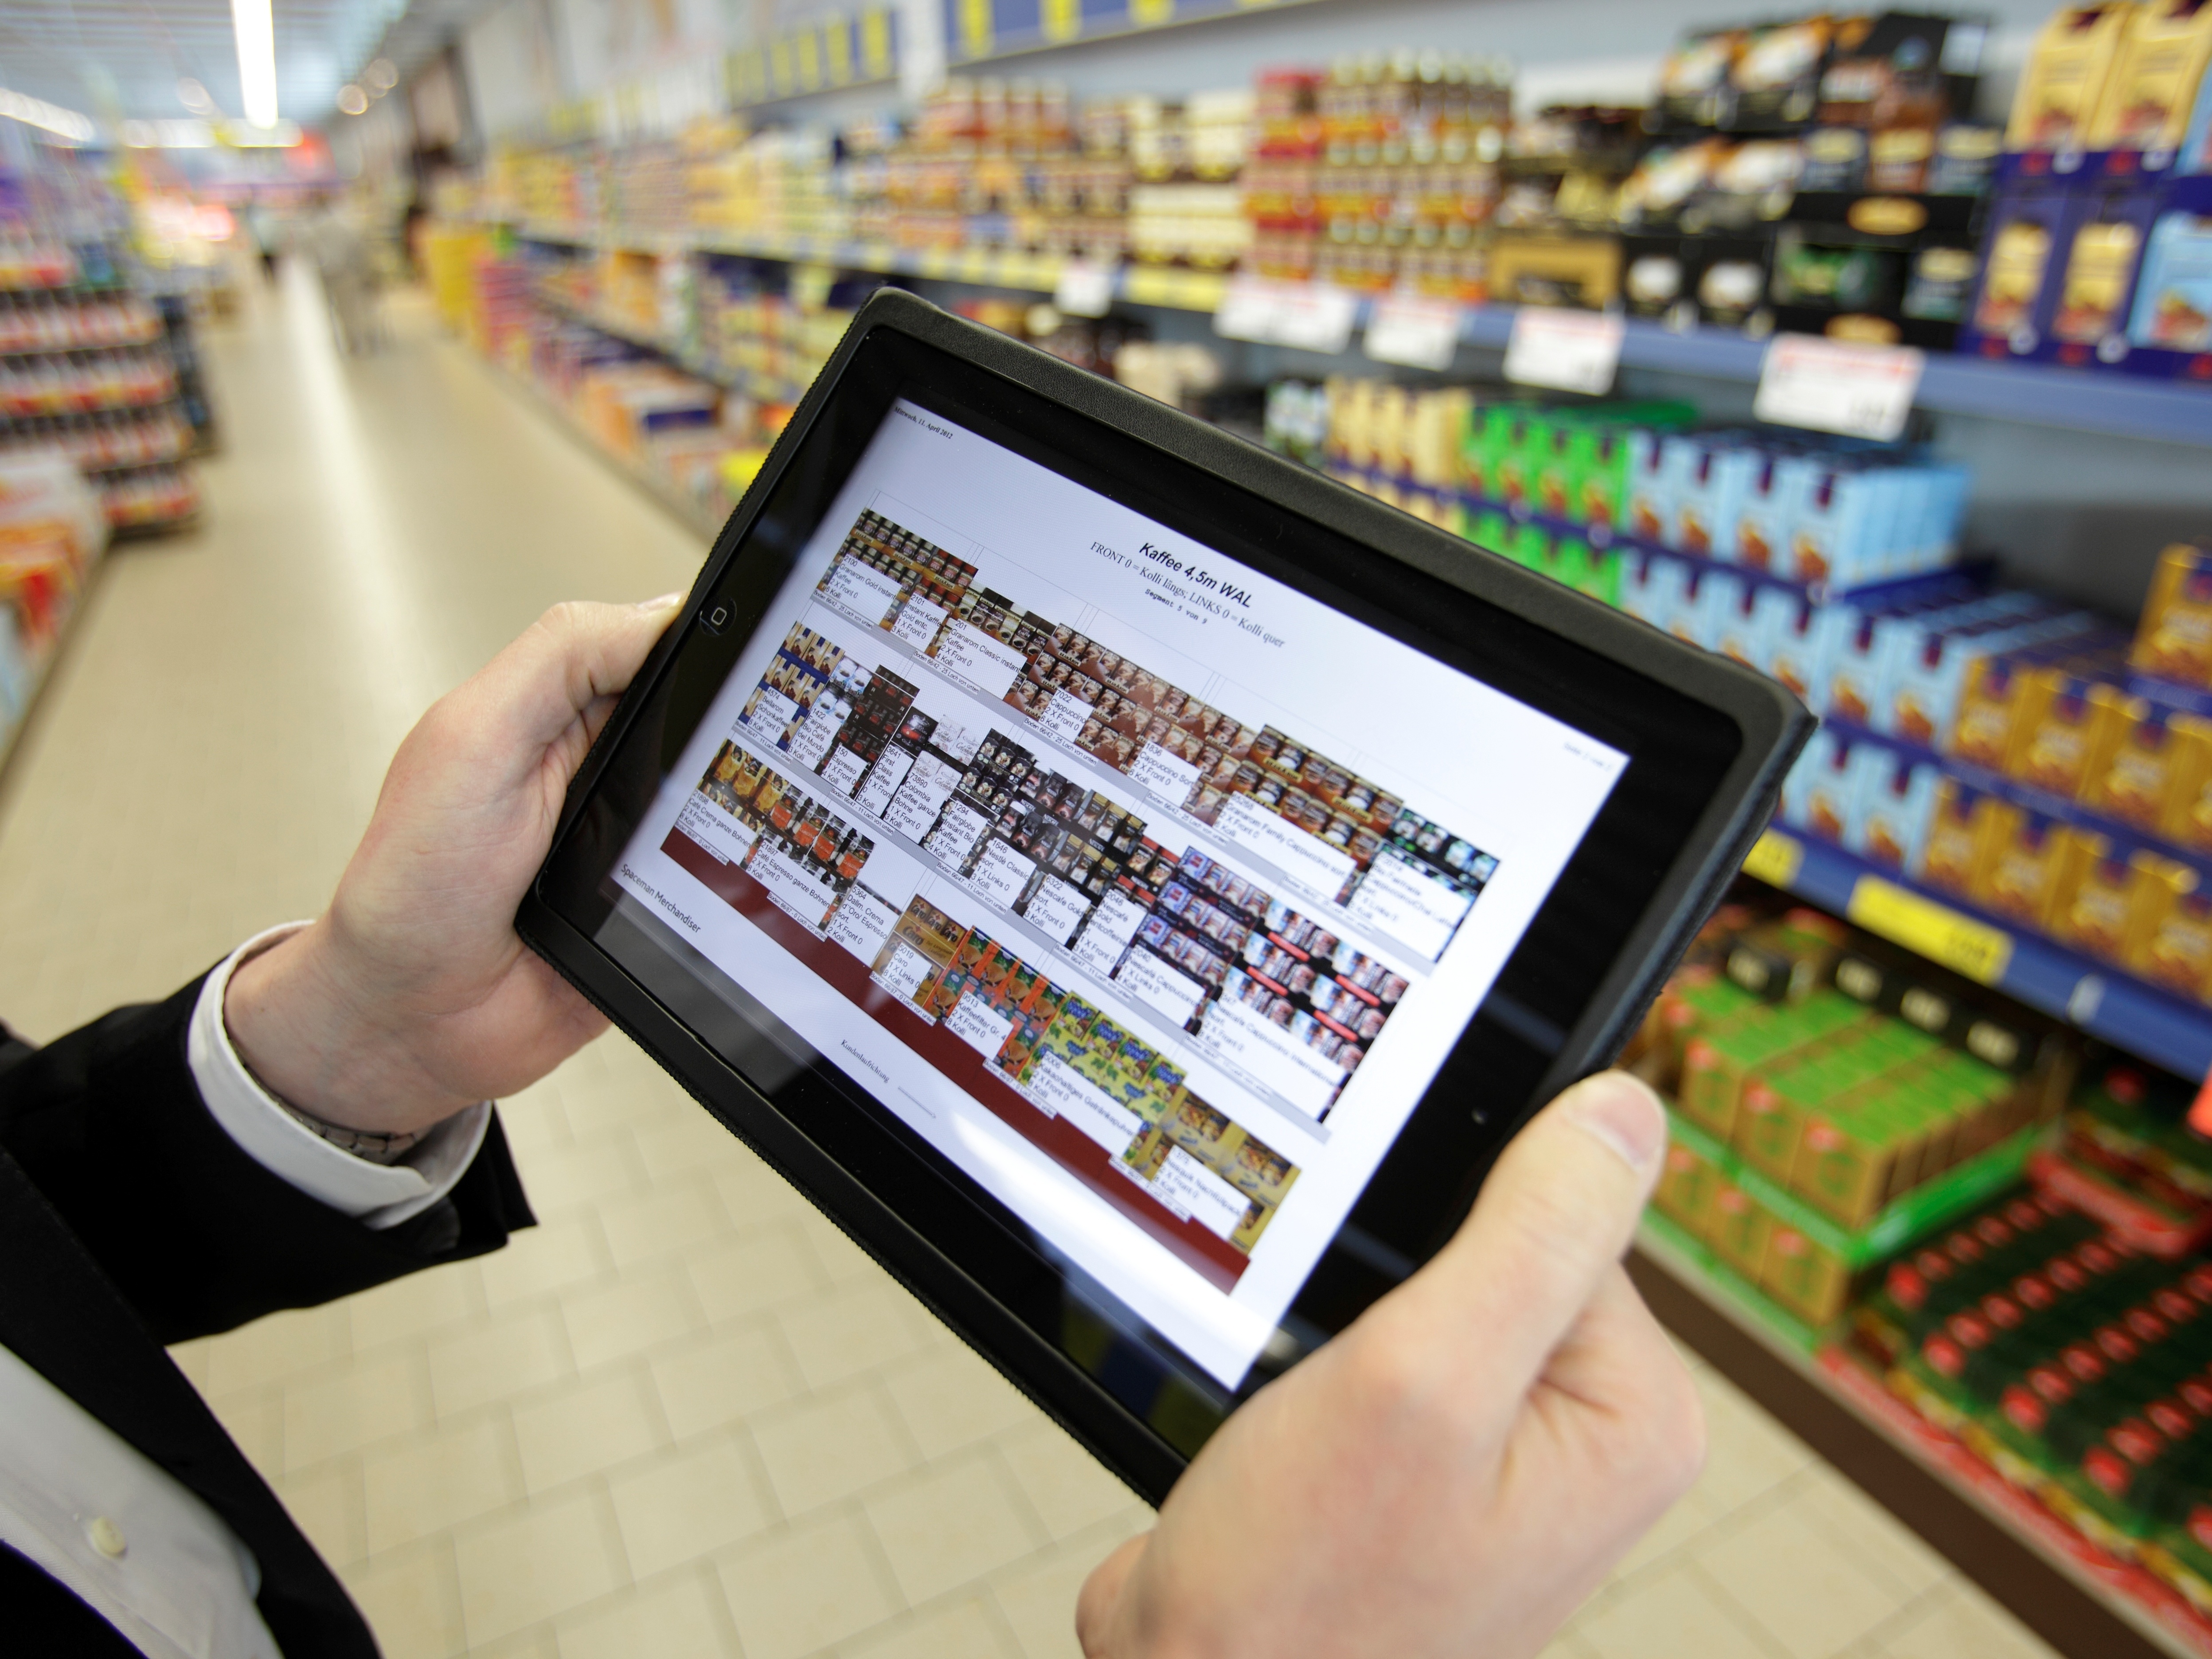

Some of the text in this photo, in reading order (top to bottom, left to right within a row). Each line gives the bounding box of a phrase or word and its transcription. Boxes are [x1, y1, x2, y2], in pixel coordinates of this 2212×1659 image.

[926, 422, 941, 434] April
[939, 429, 953, 439] 2012
[844, 555, 858, 567] 2100
[834, 571, 852, 585] Kaffee
[839, 563, 896, 600] Granarom Gold instant
[1138, 541, 1255, 608] Kaffee 4,5m WAL
[910, 594, 925, 606] 2101
[1090, 540, 1126, 564] FRONT
[1124, 558, 1133, 568] 0
[1140, 566, 1163, 584] Kolli
[1161, 578, 1190, 600] längs;
[1189, 591, 1223, 615] LINKS
[1221, 608, 1231, 619] 0
[1238, 617, 1263, 636] Kolli
[1262, 632, 1286, 650] quer
[906, 602, 925, 617] Instant
[1144, 588, 1177, 609] Segment
[1184, 610, 1200, 621] von
[900, 610, 915, 622] Gold
[955, 620, 967, 630] 201
[945, 636, 965, 651] Kaffee
[950, 628, 1021, 673] Granarom Classic instant
[940, 655, 954, 667] Kolli
[950, 650, 967, 664] Front
[766, 688, 780, 700] 4574
[1055, 689, 1072, 703] 7022
[762, 696, 785, 714] Bellarom
[1049, 698, 1087, 725] Cappuccino
[757, 703, 789, 728] Schonkaffee
[812, 708, 826, 720] 1422
[802, 723, 825, 742] Bio Café
[806, 715, 832, 736] Fairglobe
[797, 731, 825, 752] del Mundo
[837, 746, 848, 757] 150
[886, 745, 901, 759] 3641
[1145, 742, 1163, 757] 1836
[831, 754, 858, 776] Espresso
[881, 753, 895, 766] First
[1138, 751, 1179, 780] Cappuccino
[876, 762, 894, 776] Class
[872, 770, 891, 786] Kaffee
[909, 772, 928, 788] 73890
[693, 790, 709, 805] 21898
[904, 780, 932, 802] Colombia
[862, 797, 875, 810] Kolli
[894, 797, 914, 814] Bohne
[899, 788, 936, 818] Kaffee ganze
[954, 802, 969, 815] 1294
[688, 798, 752, 848] Café Crema ganze Bohnen
[889, 816, 903, 829] Kolli
[900, 812, 916, 826] Front
[947, 810, 977, 833] Fairglobe
[938, 826, 959, 844] Kaffee
[943, 818, 975, 843] Instant Bio
[761, 841, 778, 857] 21897
[933, 847, 947, 860] Kolli
[992, 839, 1008, 853] 1646
[1006, 861, 1030, 880] Classic
[756, 849, 831, 908] Café Espresso ganze Bohnen
[976, 876, 991, 890] Kolli
[987, 872, 1004, 887] Links
[1045, 875, 1063, 890] 6322
[619, 863, 702, 934] Spaceman Merchandiser
[852, 885, 867, 900] 5364
[837, 910, 851, 923] sort.
[847, 894, 885, 925] Dallm. Crema
[1067, 902, 1084, 916] Gold
[1094, 908, 1113, 923] Gold
[842, 926, 858, 941] Front
[860, 916, 888, 941] Espresso
[901, 923, 926, 947] Caro
[832, 930, 845, 943] Kolli
[898, 944, 915, 959] 5019
[893, 952, 909, 967] Caro
[962, 992, 979, 1007] 9513
[957, 1000, 990, 1029] Kaffeefilter
[989, 1025, 1001, 1037] Gr.
[840, 1039, 891, 1084] Kundenlaufrichtung
